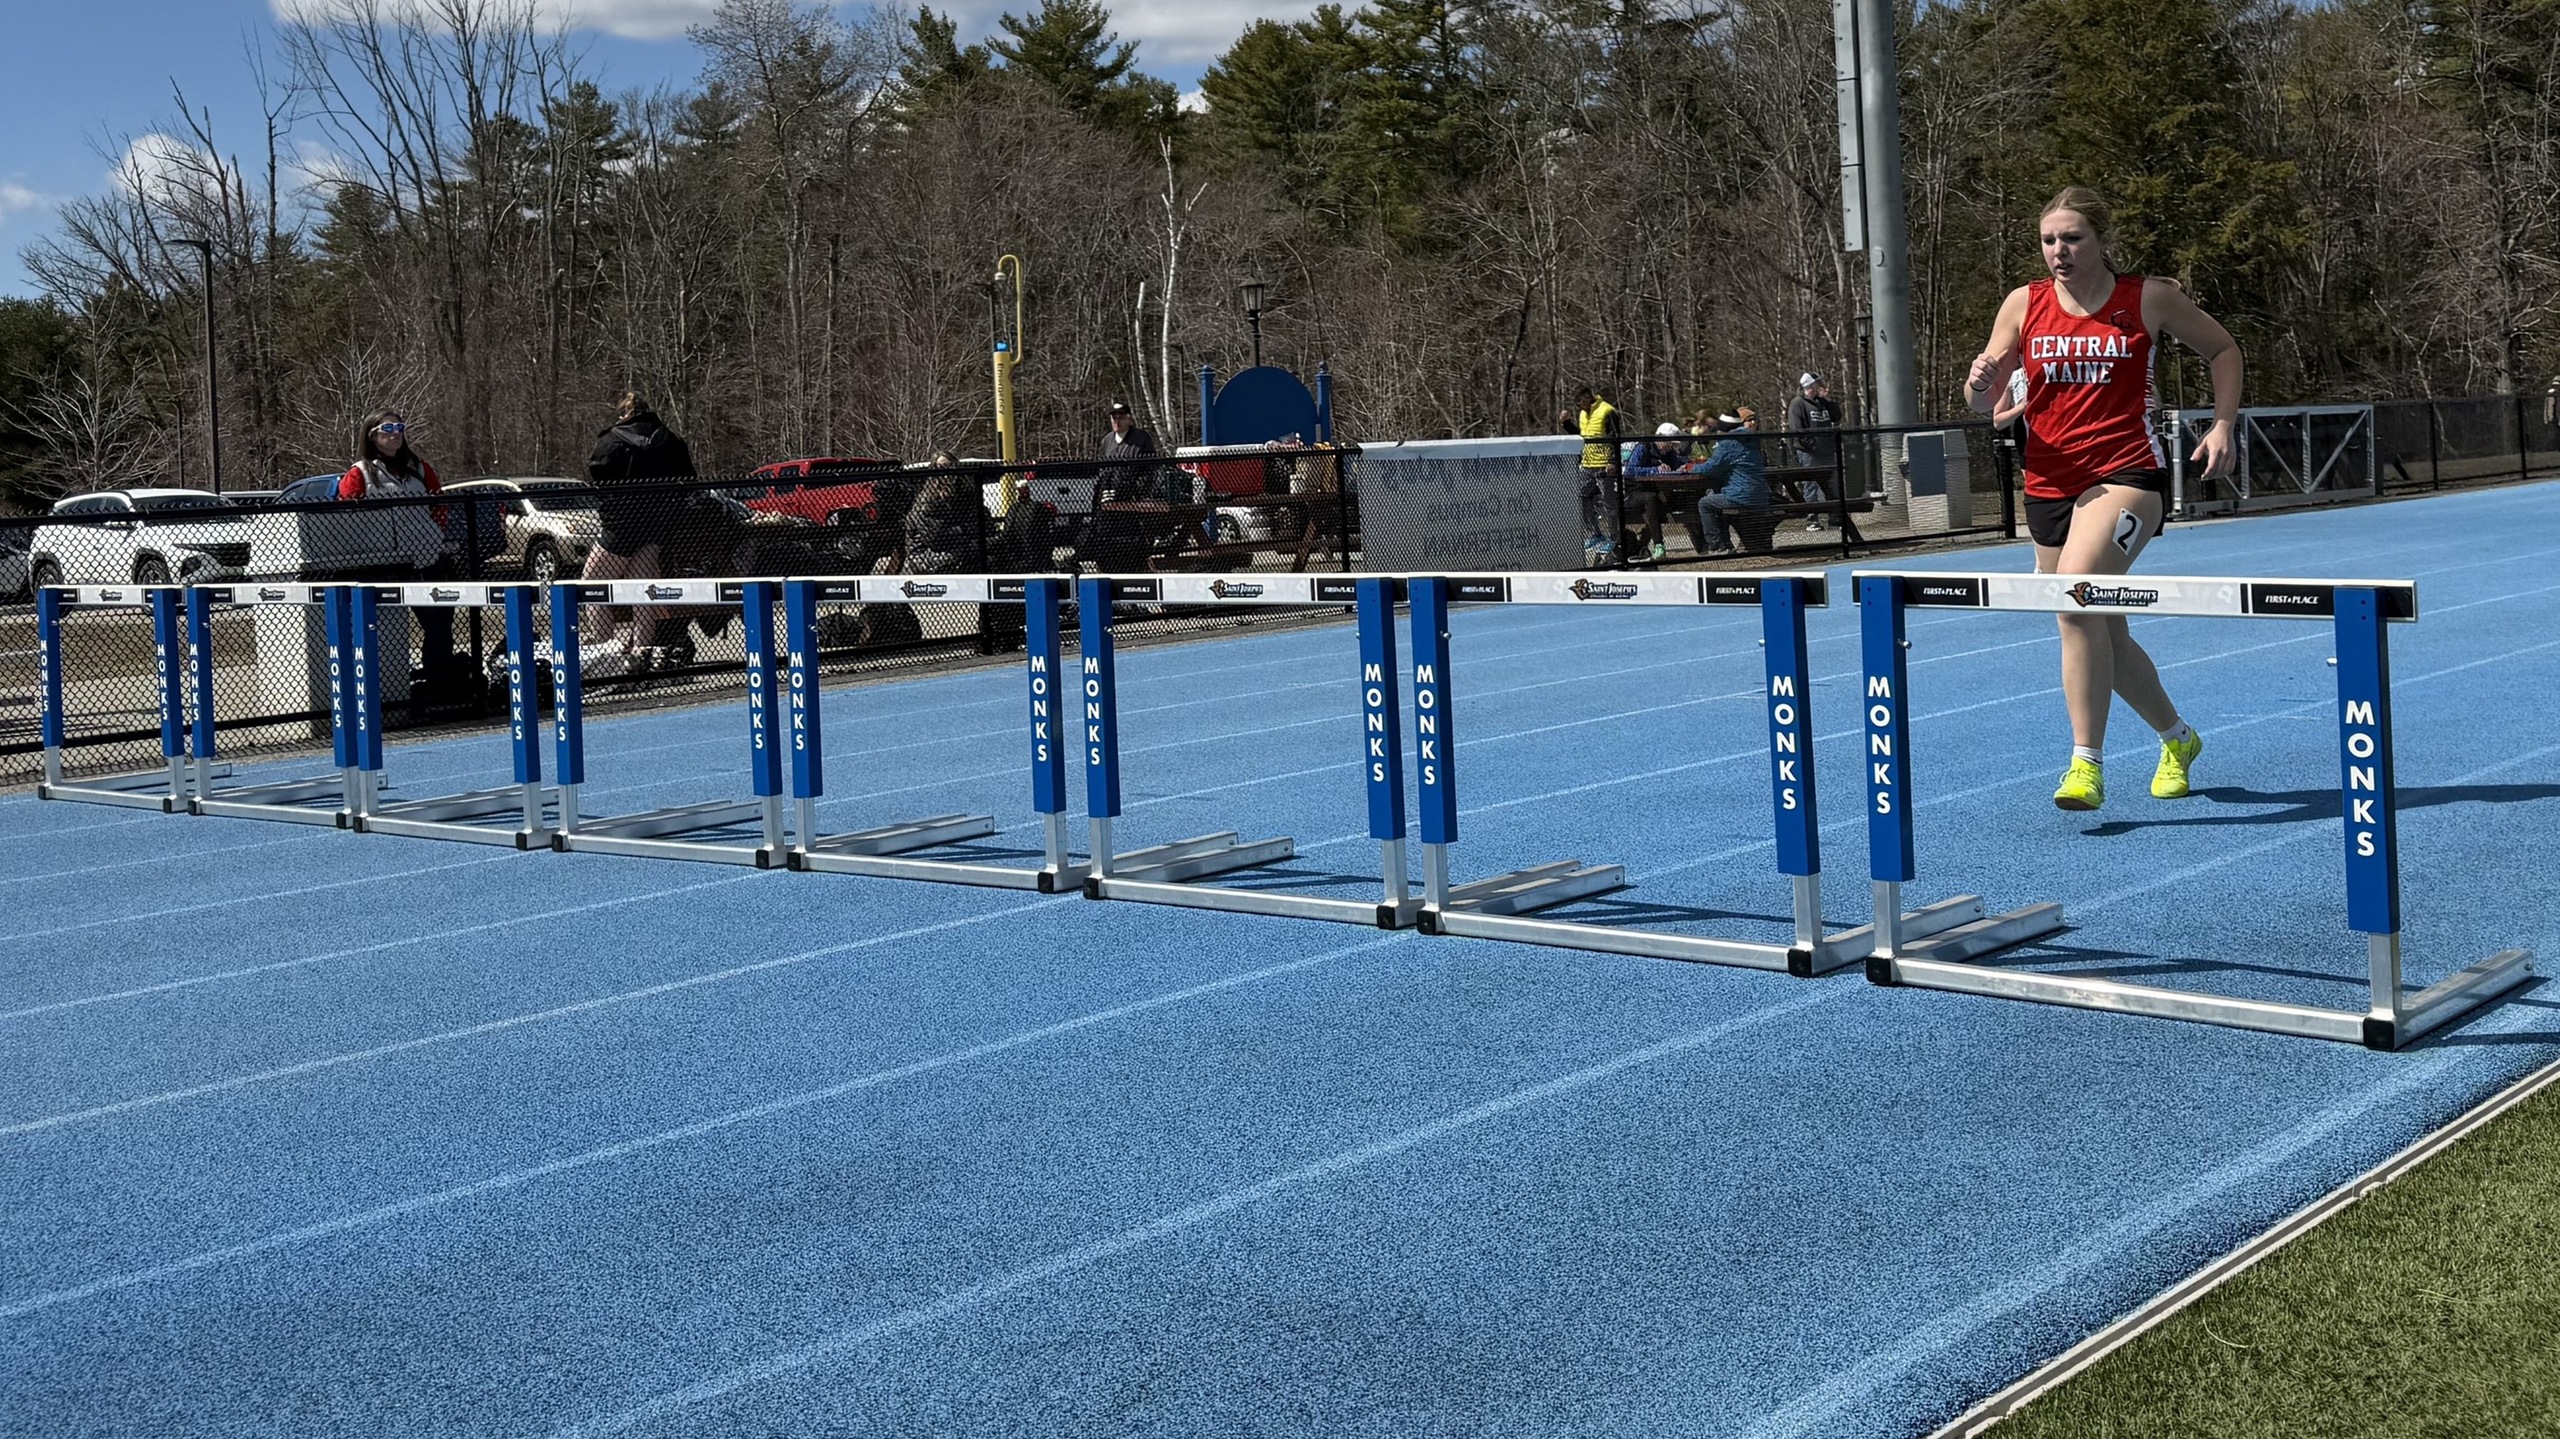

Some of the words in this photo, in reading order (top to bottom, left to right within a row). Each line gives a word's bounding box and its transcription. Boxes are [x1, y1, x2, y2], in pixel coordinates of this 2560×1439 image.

[2030, 334, 2133, 360] CENTRAL
[2041, 360, 2114, 384] MAINE
[2117, 514, 2137, 551] 2
[2091, 588, 2119, 598] SAINT
[41, 640, 49, 712] MONKS
[157, 644, 168, 720] MONKS
[190, 643, 199, 720] MONKS
[330, 646, 341, 727] MONKS
[355, 647, 365, 730] MONKS
[510, 651, 522, 740] MONKS
[554, 651, 566, 741] MONKS
[748, 652, 763, 749] MONKS
[790, 652, 804, 750] MONKS
[1031, 656, 1047, 761] MONKS
[1084, 657, 1100, 765] MONKS
[1365, 664, 1384, 782] MONKS
[1416, 664, 1436, 785] MONKS
[1772, 675, 1797, 810] MONKS
[1867, 676, 1892, 814] MONKS
[2345, 700, 2376, 857] MONKS
